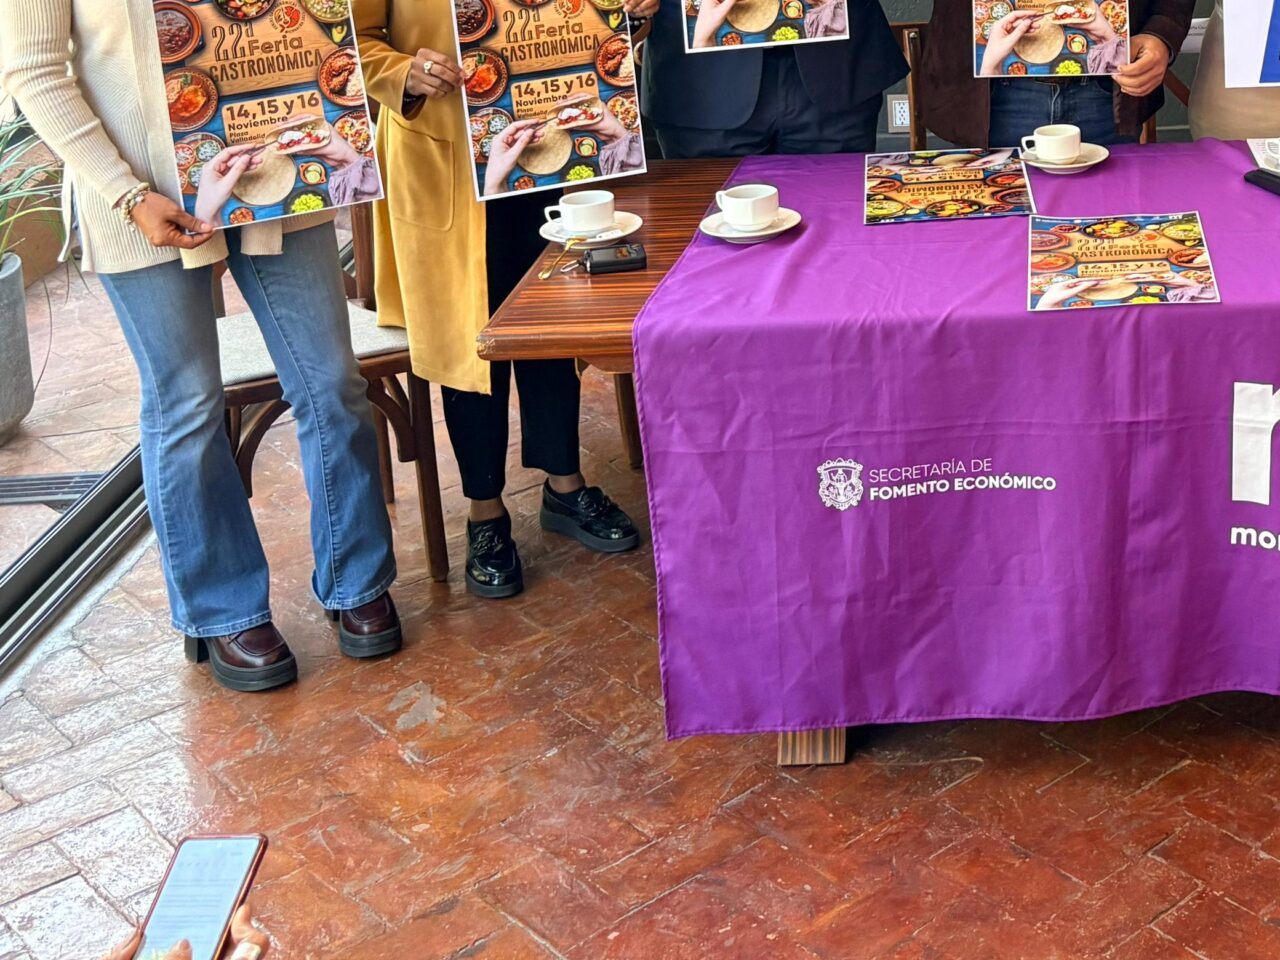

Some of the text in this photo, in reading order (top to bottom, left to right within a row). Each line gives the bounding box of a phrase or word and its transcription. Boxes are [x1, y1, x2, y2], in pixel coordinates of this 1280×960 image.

[534, 20, 583, 39] Feria
[247, 35, 303, 56] Feria
[501, 34, 599, 62] GASTRONÓMICA
[210, 49, 323, 82] GASTRONÓMICA
[564, 79, 573, 93] y
[576, 73, 595, 88] 16
[283, 99, 294, 115] y
[297, 92, 319, 109] 16
[515, 94, 568, 107] Noviembre
[228, 116, 289, 132] Noviembre
[229, 130, 249, 138] Plaza
[869, 458, 992, 482] SECRETARÍA DE
[870, 473, 1056, 501] FOMENTO ECONÓMICO
